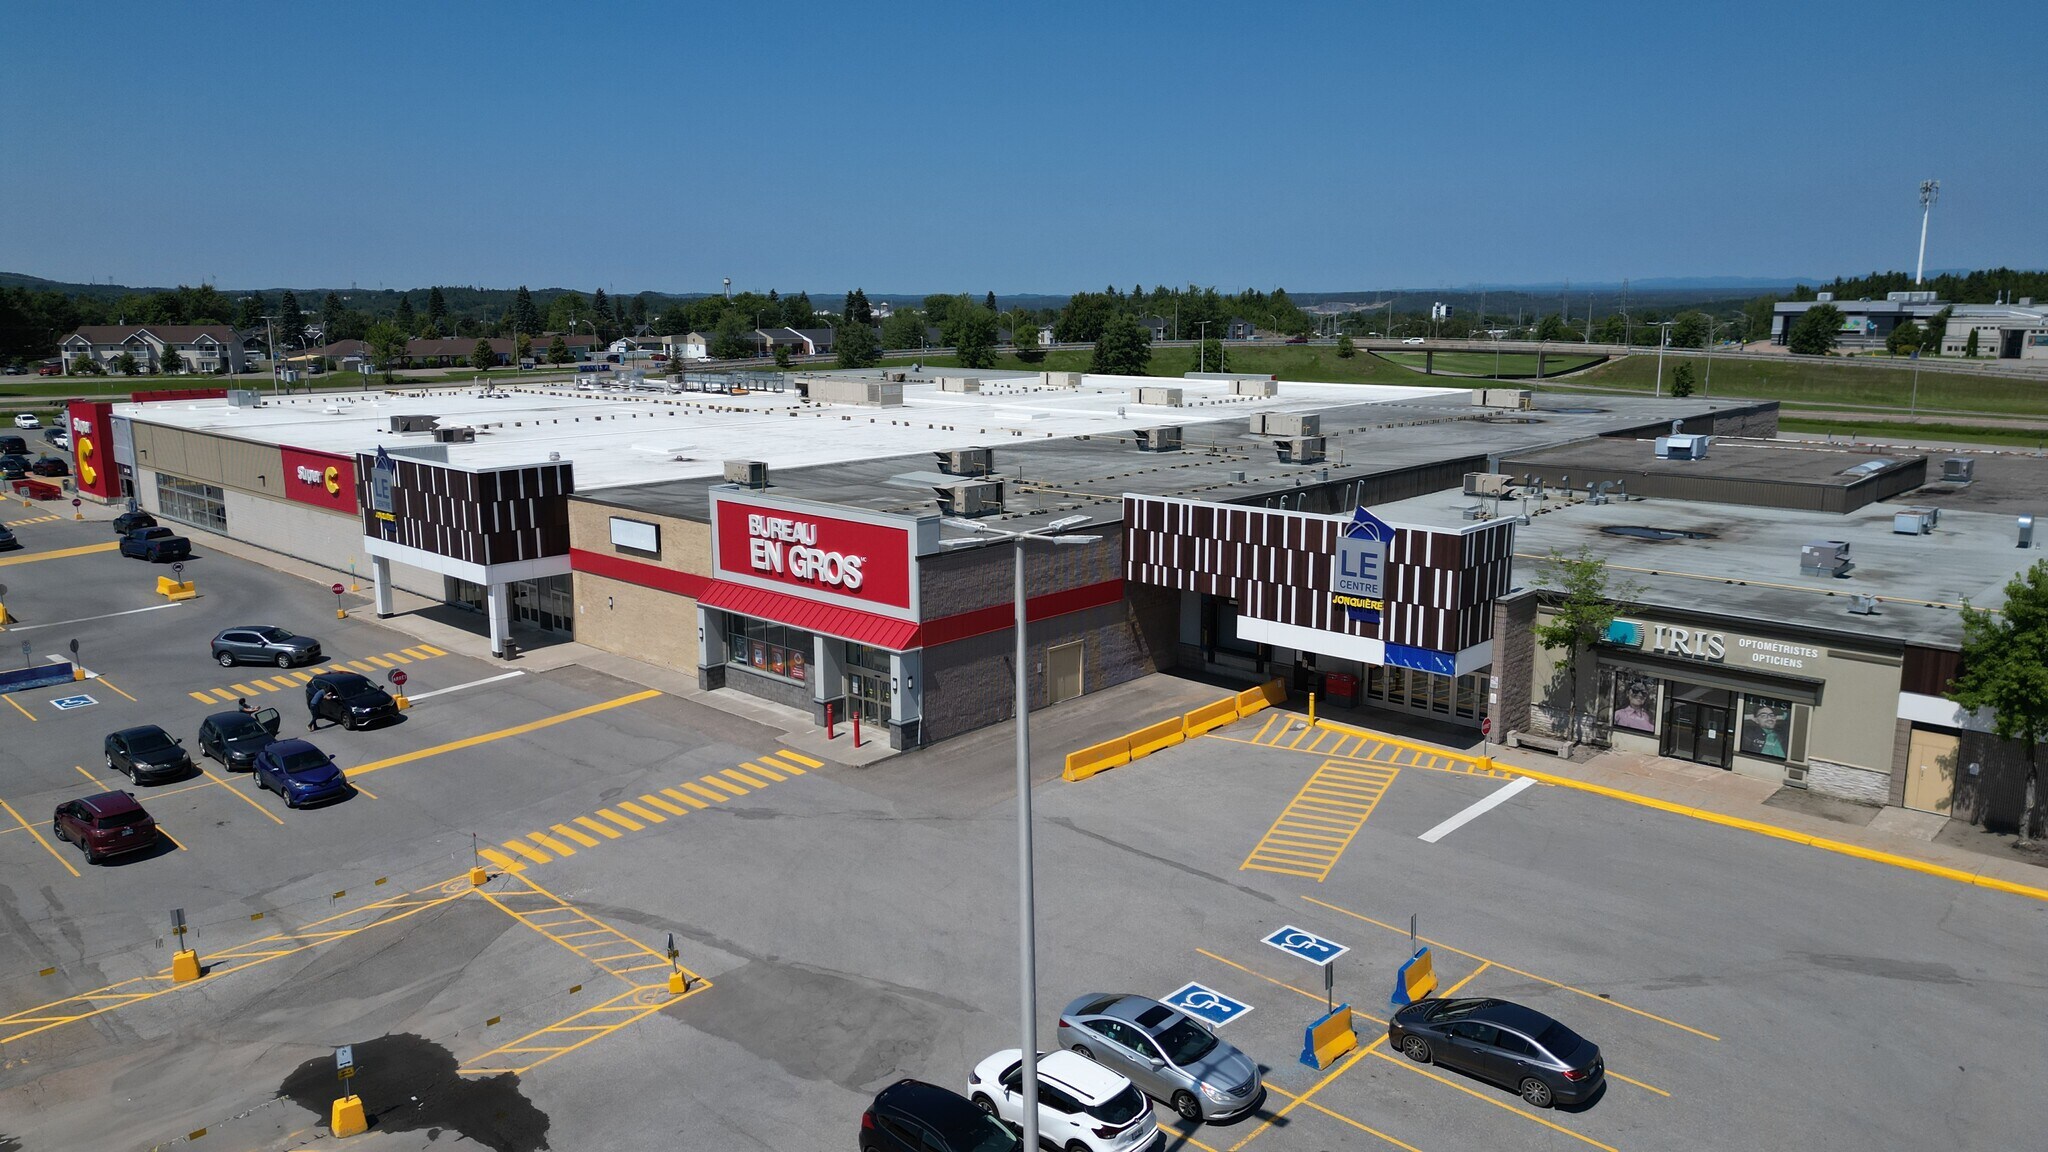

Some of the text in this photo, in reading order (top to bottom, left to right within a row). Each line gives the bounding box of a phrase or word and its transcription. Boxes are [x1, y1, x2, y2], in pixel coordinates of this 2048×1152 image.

[78, 437, 97, 485] C
[297, 465, 340, 494] Super C
[374, 478, 390, 499] LE
[748, 514, 817, 546] BUREAU
[750, 537, 783, 573] EN
[788, 545, 863, 589] GROS
[1341, 549, 1378, 580] LE
[1339, 579, 1378, 594] CENTRE
[1332, 594, 1385, 611] JONQUIÈRE
[1654, 624, 1725, 660] IRIS
[1738, 637, 1819, 659] OPTOMÉTRISTES
[1752, 653, 1803, 669] OPTICIENS
[1749, 697, 1788, 711] IRIS
